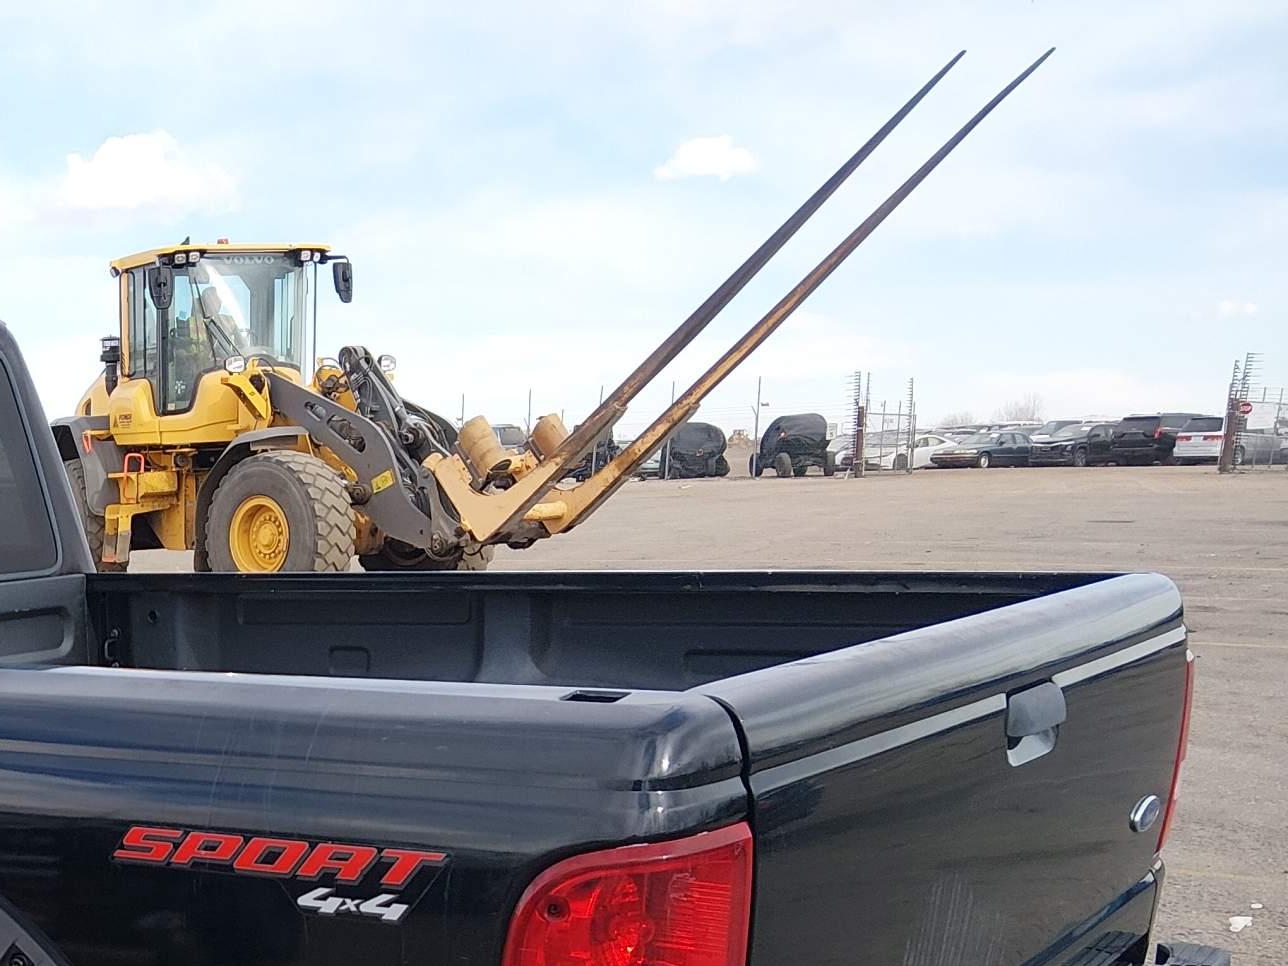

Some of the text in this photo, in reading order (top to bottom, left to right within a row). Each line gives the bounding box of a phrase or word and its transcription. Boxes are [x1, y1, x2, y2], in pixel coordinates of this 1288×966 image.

[223, 255, 275, 265] VOLVO
[112, 824, 447, 888] SPORT
[296, 886, 408, 922] 4x4
